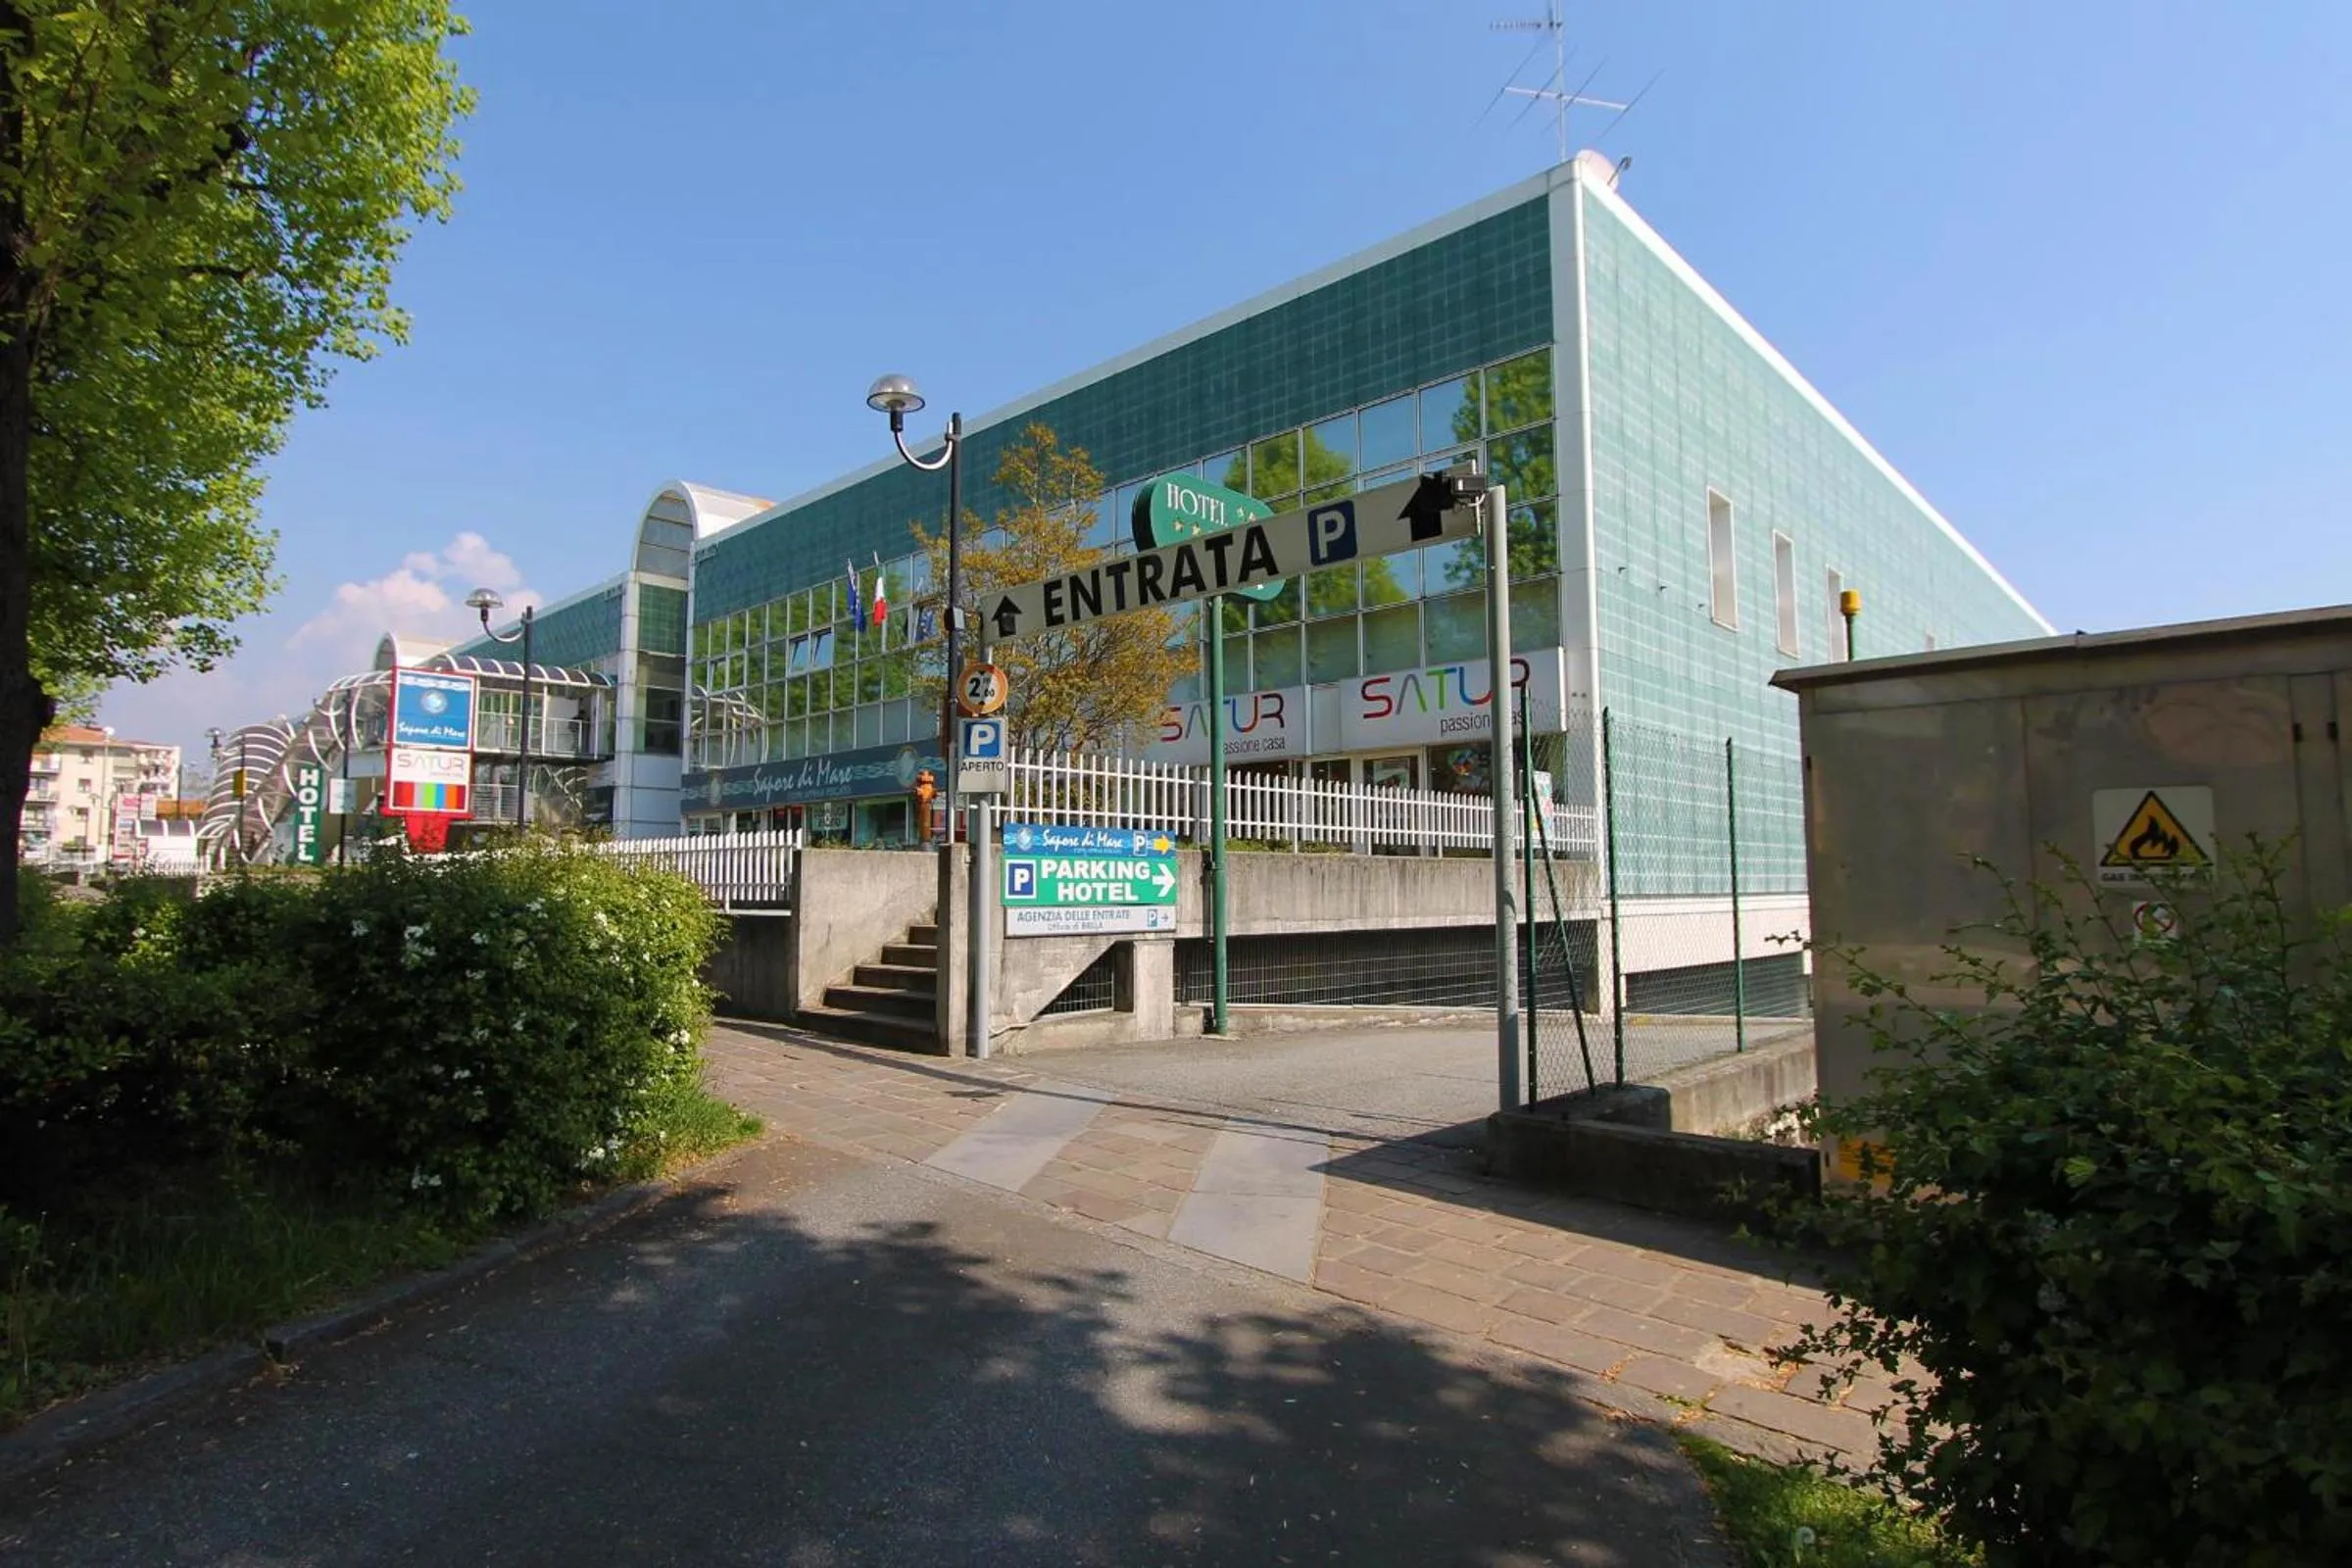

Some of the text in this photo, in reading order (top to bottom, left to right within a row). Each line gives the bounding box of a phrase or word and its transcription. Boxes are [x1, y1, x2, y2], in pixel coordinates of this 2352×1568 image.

[1166, 482, 1229, 527] HOTEL
[1043, 510, 1347, 628] ENTRATA P
[1159, 692, 1285, 743] SAUR
[1440, 711, 1491, 735] passion
[970, 723, 996, 756] P
[1222, 737, 1287, 755] assione casa
[397, 754, 465, 771] SATUR
[960, 760, 1004, 772] APERTO
[754, 767, 795, 804] Sapore
[798, 760, 812, 788] di
[815, 758, 853, 786] Mare
[298, 768, 319, 861] HOTEL
[1043, 829, 1079, 852] Sapore
[1081, 831, 1096, 848] di
[1097, 831, 1123, 849] Mare
[1014, 858, 1152, 892] P PARKING
[1057, 882, 1139, 902] HOTEL
[1017, 910, 1062, 922] AGENZIA
[1064, 910, 1090, 921] DELLE
[1092, 908, 1130, 920] ENTRATE
